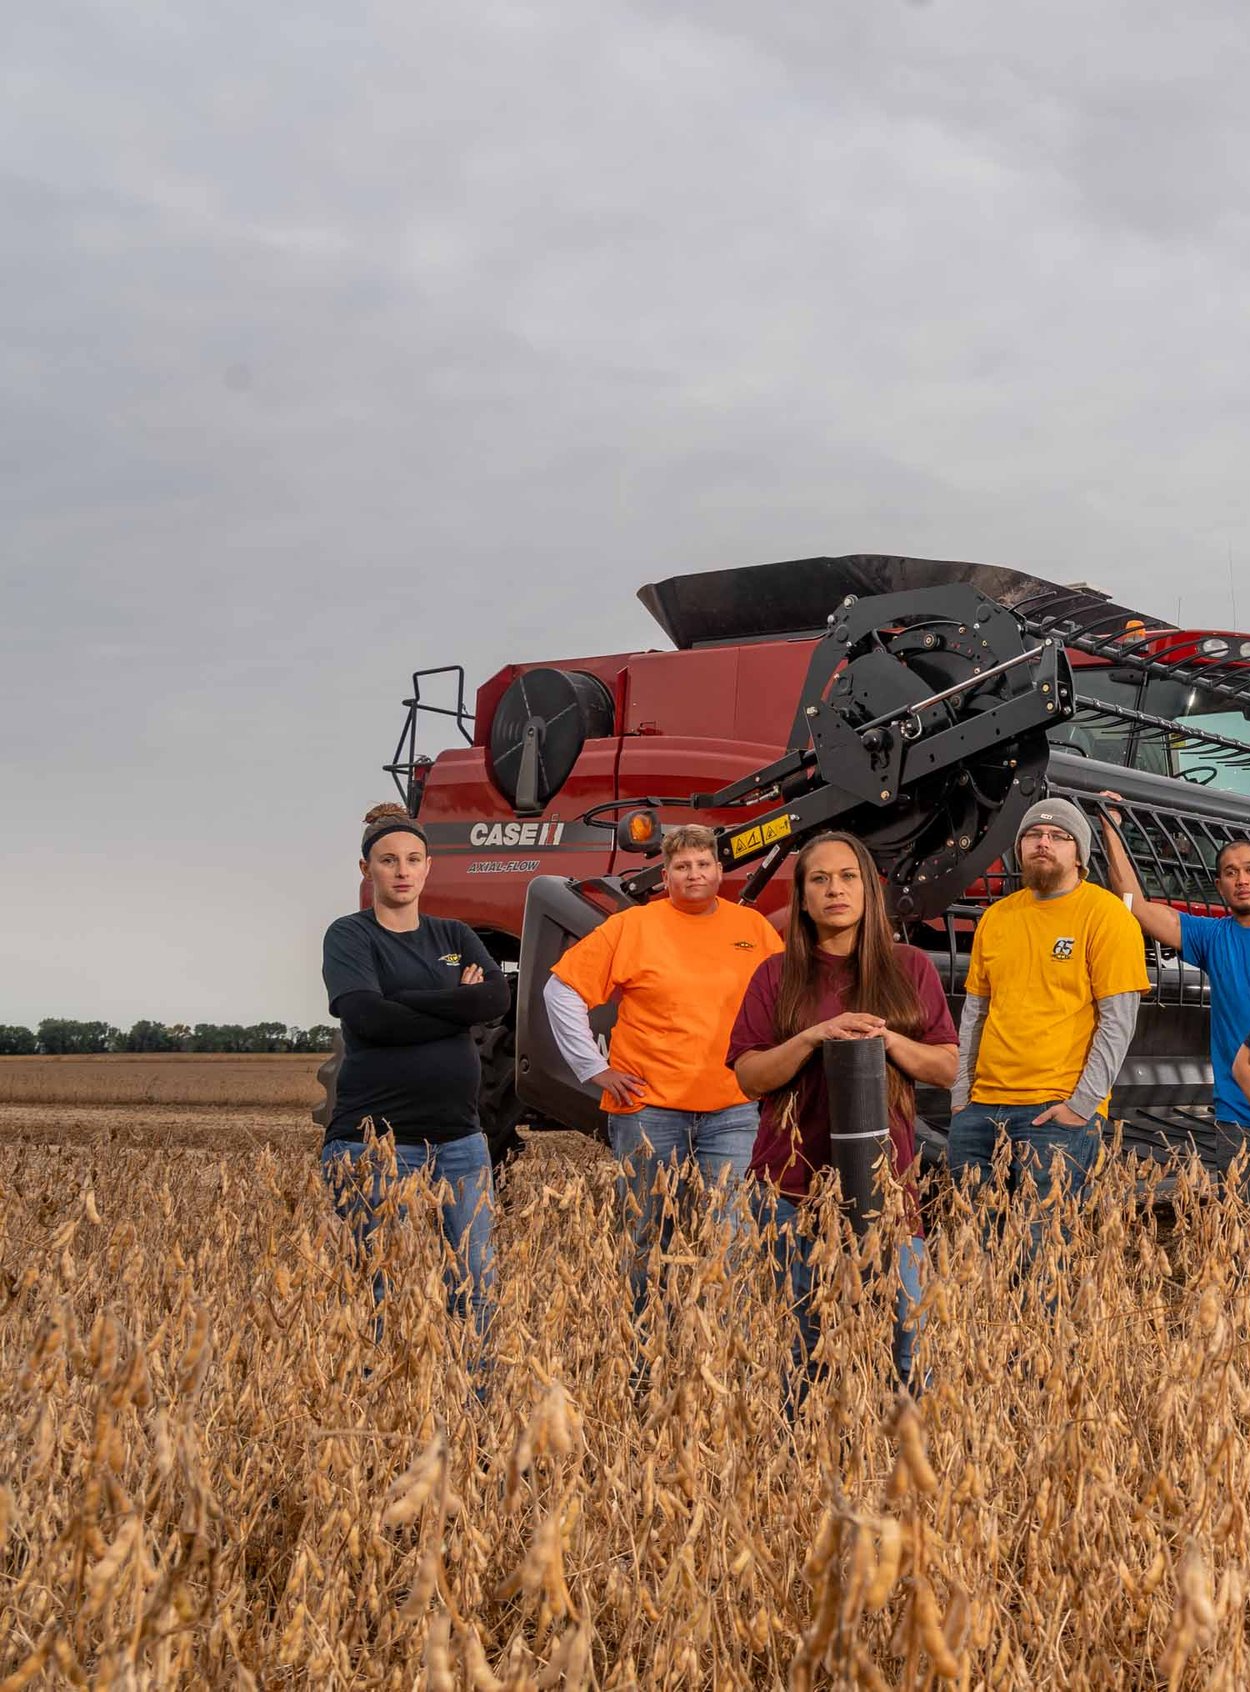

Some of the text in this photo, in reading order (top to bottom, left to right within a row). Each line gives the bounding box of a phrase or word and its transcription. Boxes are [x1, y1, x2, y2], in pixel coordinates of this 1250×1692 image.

[470, 822, 539, 847] CASE
[466, 860, 541, 874] AXIAL-FLOW
[1053, 939, 1075, 955] 65
